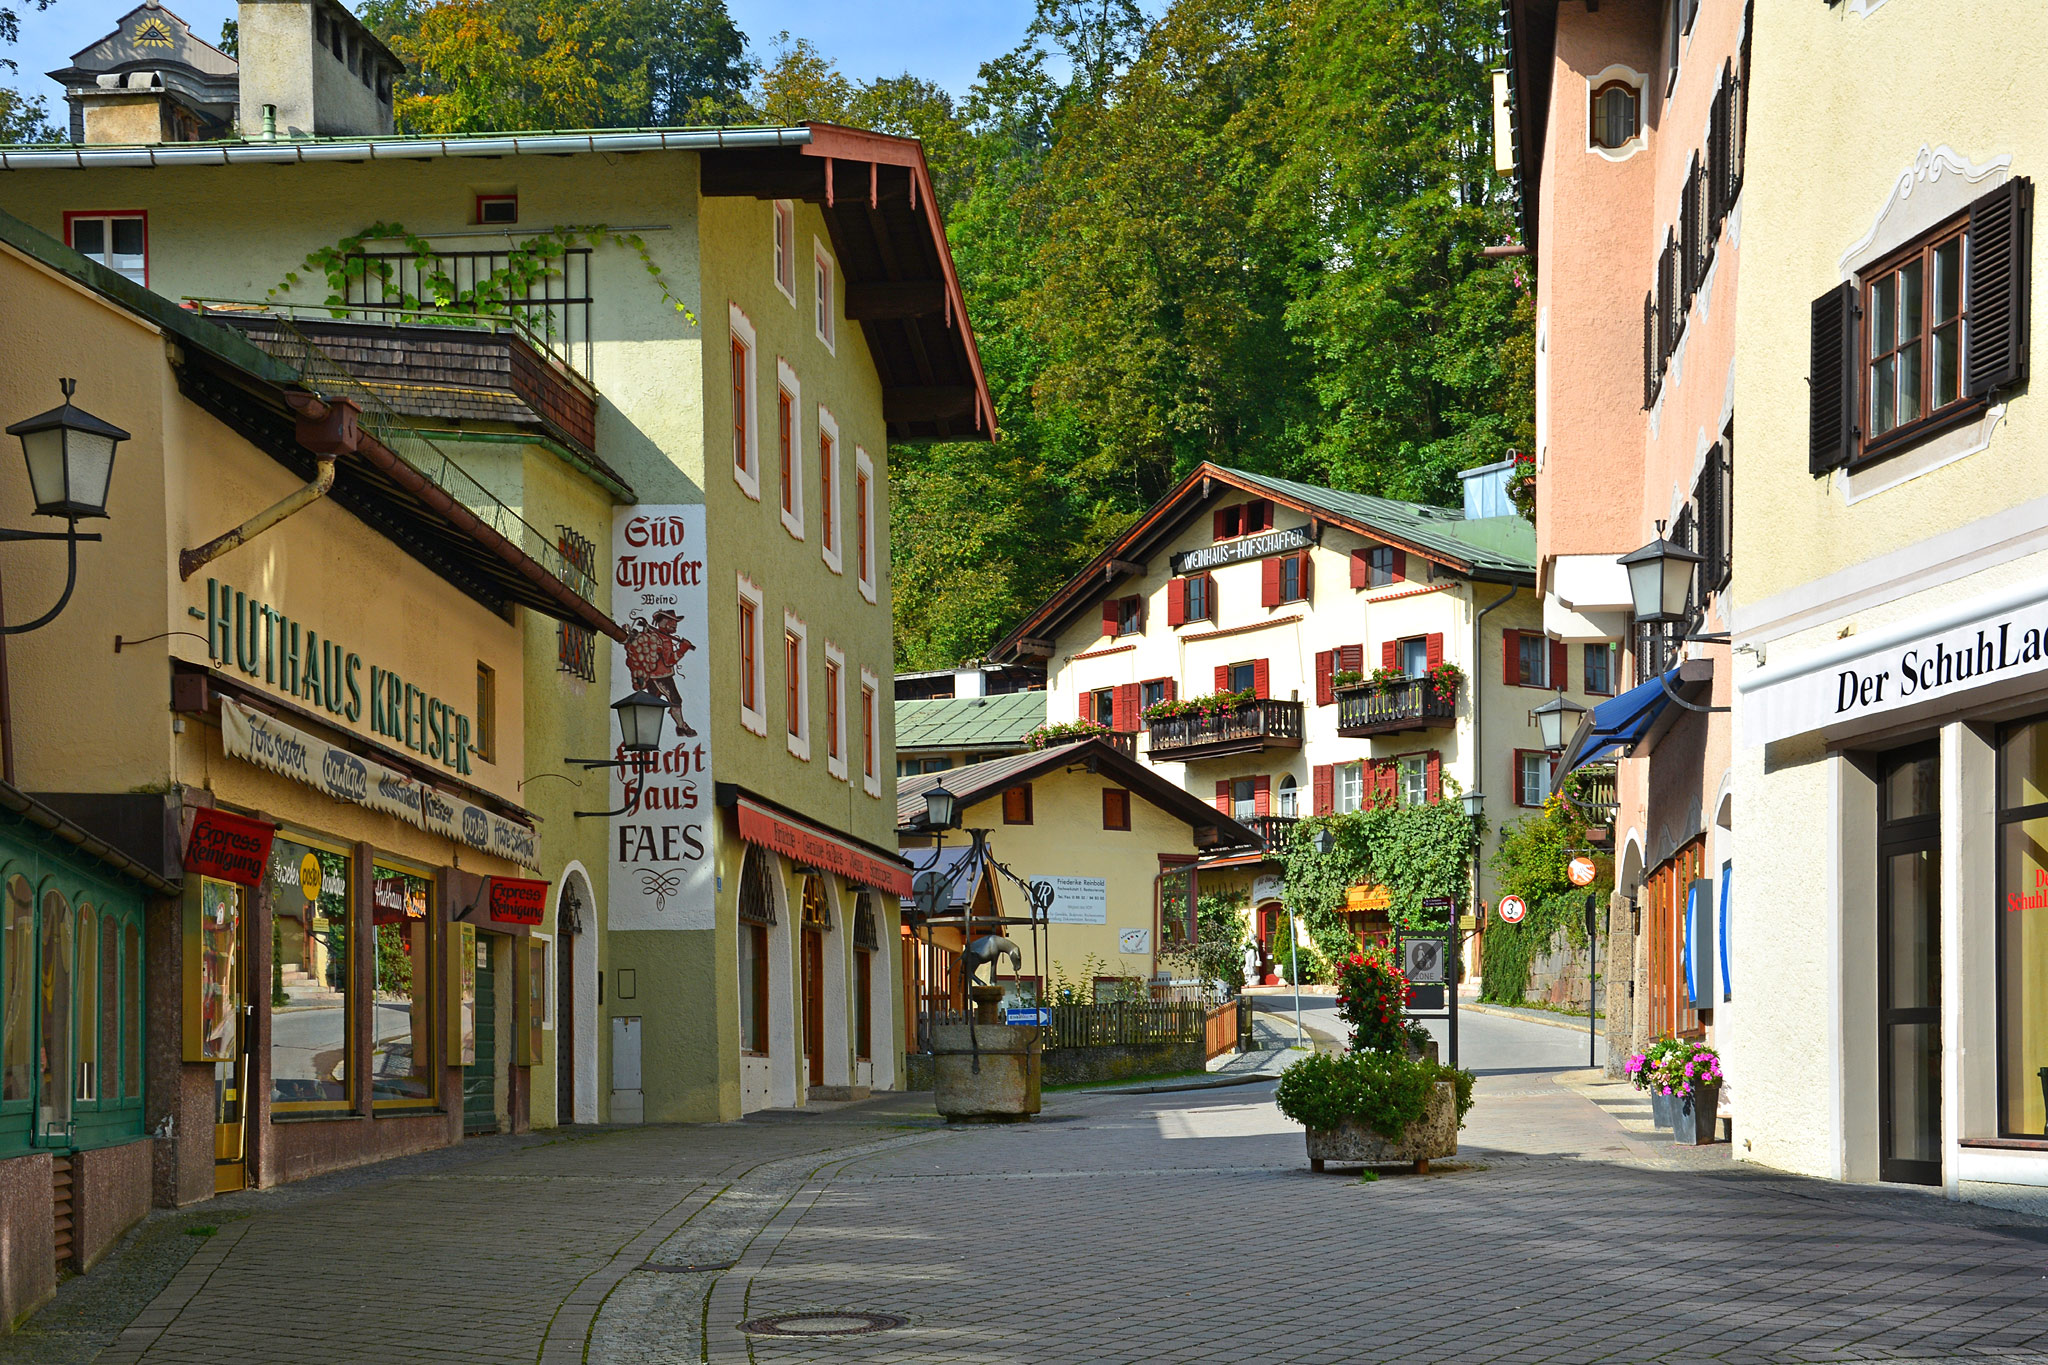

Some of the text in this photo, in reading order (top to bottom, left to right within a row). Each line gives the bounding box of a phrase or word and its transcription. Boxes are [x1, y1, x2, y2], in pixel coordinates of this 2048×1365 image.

[625, 516, 684, 548] Süd
[616, 552, 703, 592] Tyroler
[641, 594, 678, 605] Weine
[1835, 622, 2048, 714] Der SchuhLa
[623, 778, 698, 817] haus
[194, 820, 262, 853] Express
[618, 824, 705, 863] FAES
[187, 840, 262, 879] Reinigung
[492, 883, 542, 902] Express
[489, 899, 544, 923] Reinigung
[1415, 972, 1435, 980] ZONE
